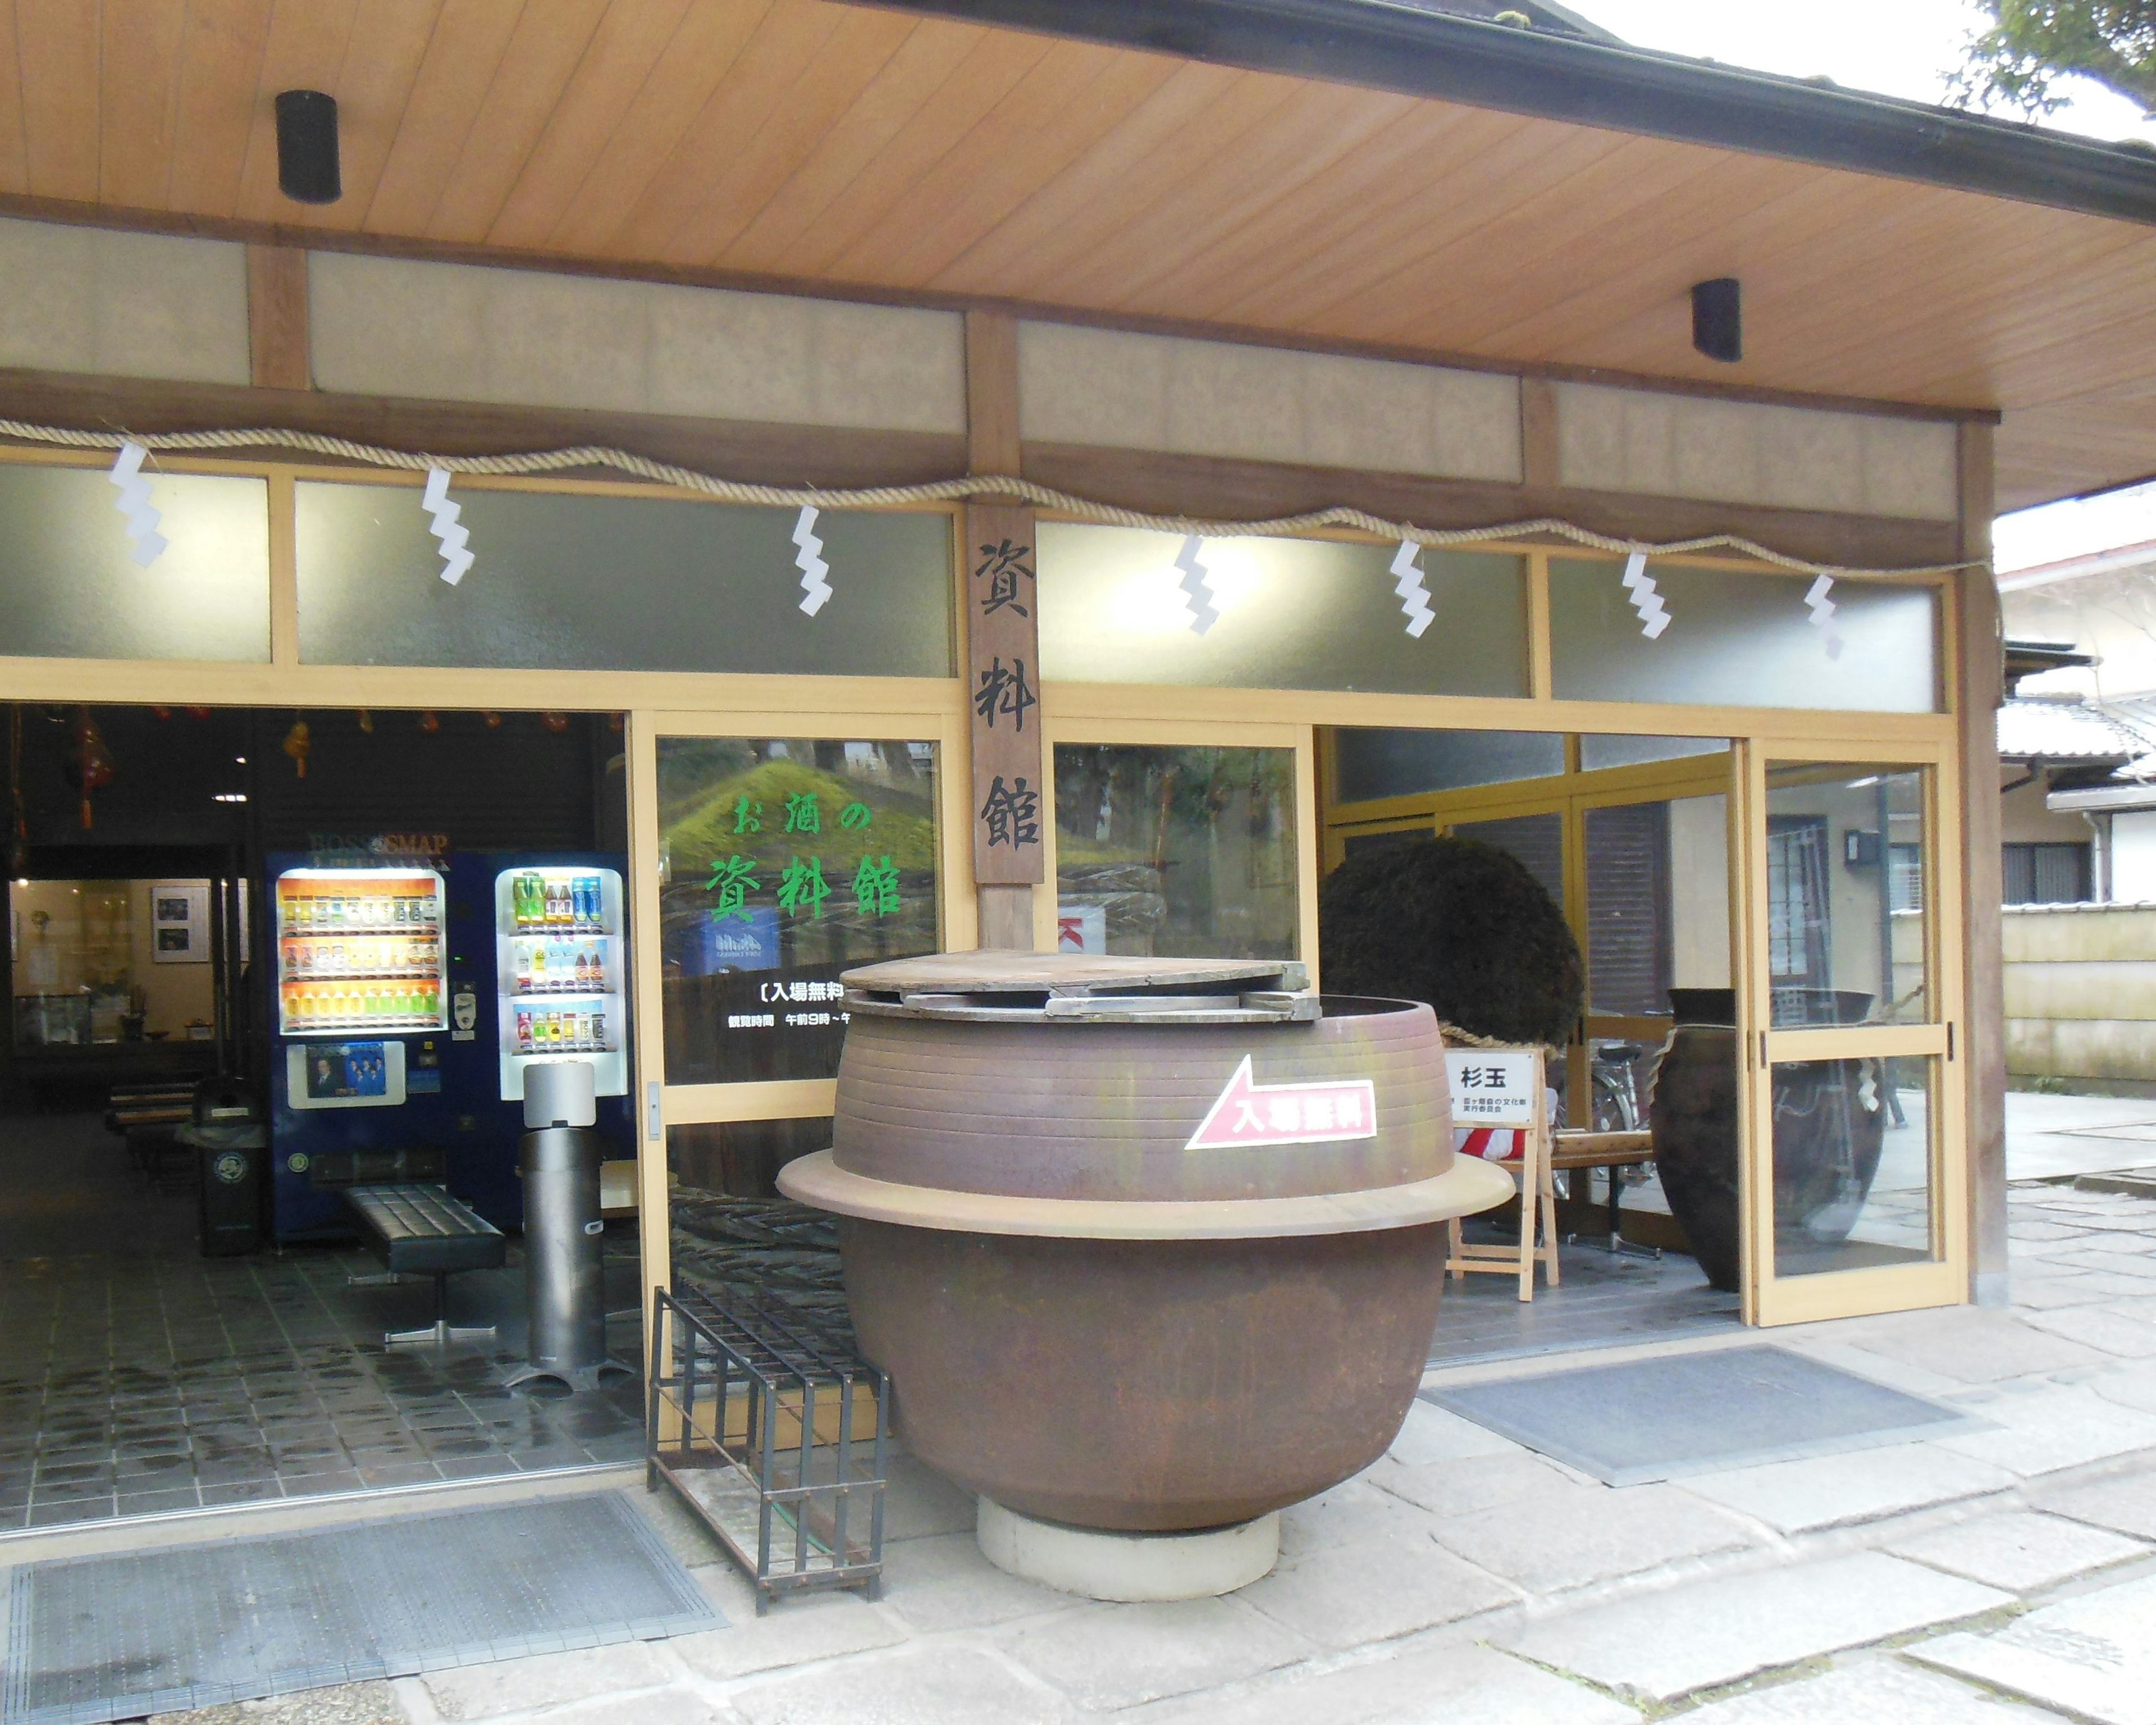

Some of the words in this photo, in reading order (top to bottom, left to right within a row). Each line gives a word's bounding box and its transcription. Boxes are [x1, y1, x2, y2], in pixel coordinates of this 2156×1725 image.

[975, 539, 1039, 851] 資料館
[733, 792, 871, 834] お酒の
[706, 855, 901, 923] 資料館
[728, 1015, 774, 1028] 観覧時間
[1461, 1066, 1506, 1088] 杉玉
